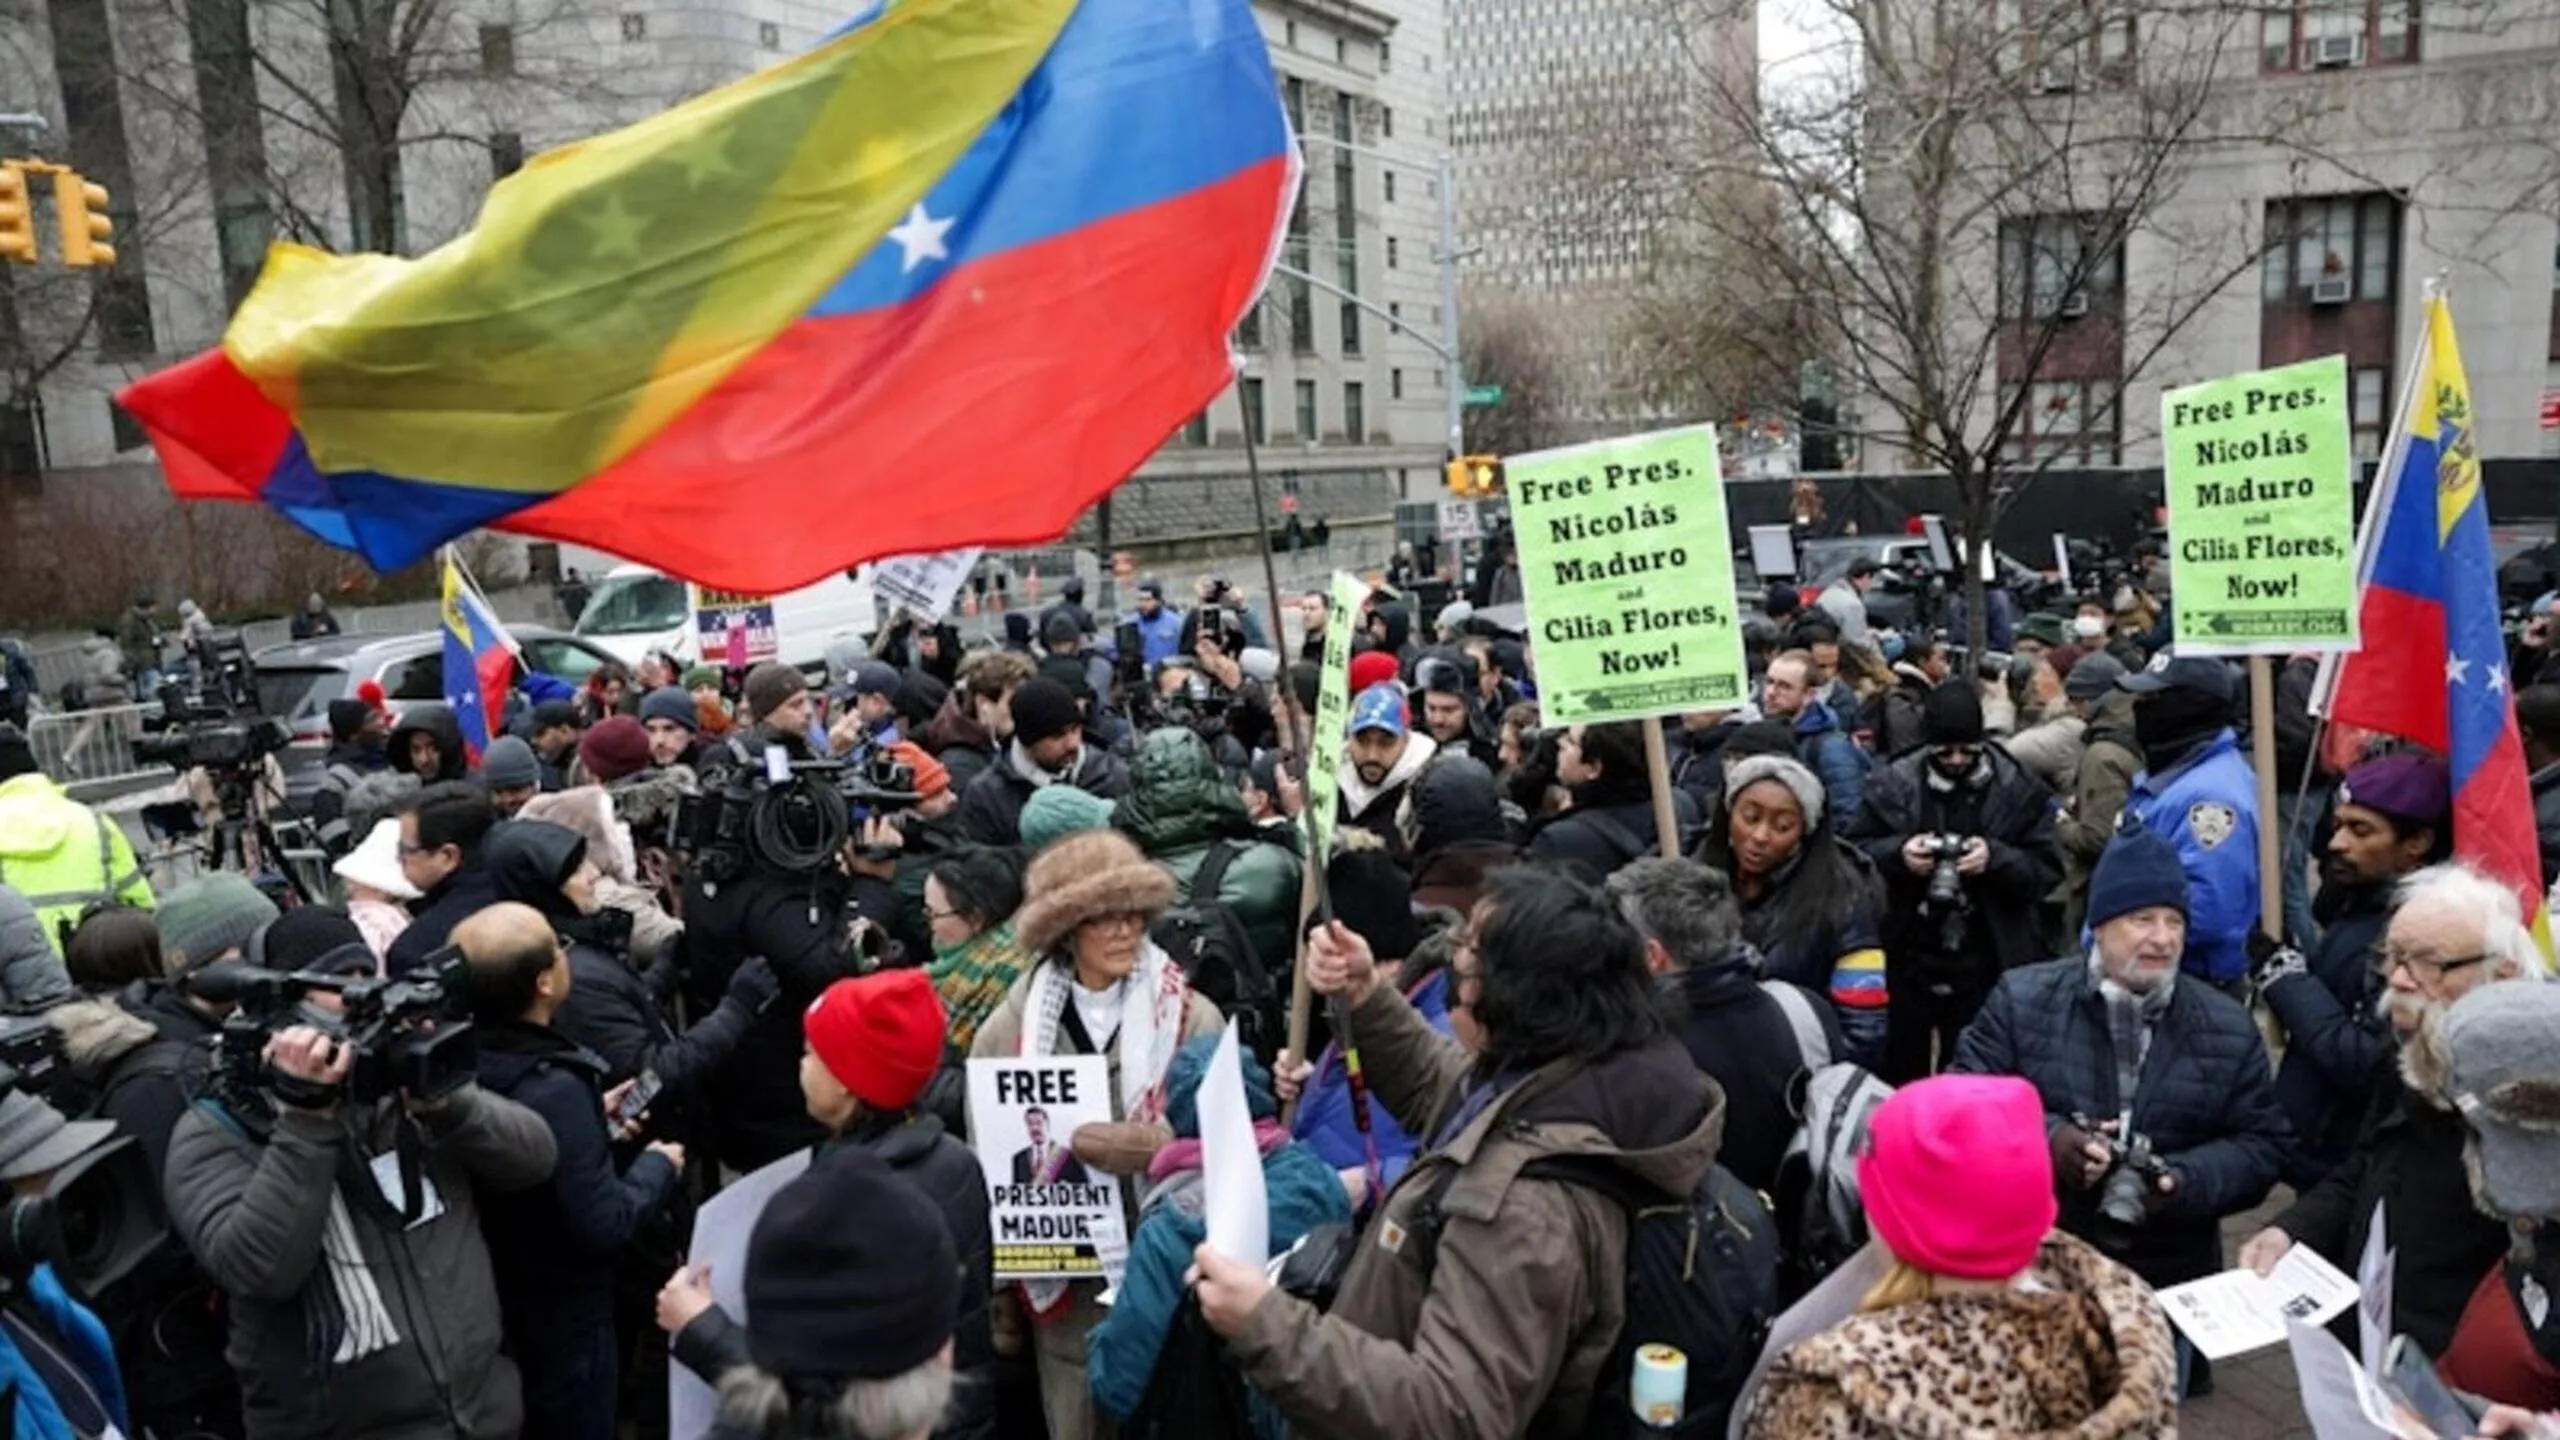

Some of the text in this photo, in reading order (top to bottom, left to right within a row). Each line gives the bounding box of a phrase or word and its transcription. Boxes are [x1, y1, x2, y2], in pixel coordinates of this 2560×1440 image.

[2172, 386, 2327, 427] Free Pres.
[2195, 430, 2309, 468] Nicolás
[1519, 457, 1694, 506] Free Pres.
[2196, 476, 2314, 509] Maduro
[1549, 501, 1679, 544] Nicolás
[1554, 545, 1688, 586] Maduro
[2183, 535, 2345, 563] Cilia Flores,
[2227, 572, 2299, 600] Now!
[1544, 601, 1728, 644] Cilia Flores,
[1600, 643, 1681, 675] Now!
[996, 1069, 1078, 1104] FREE
[993, 1184, 1111, 1207] PRESIDENT
[1000, 1213, 1103, 1239] MADUR
